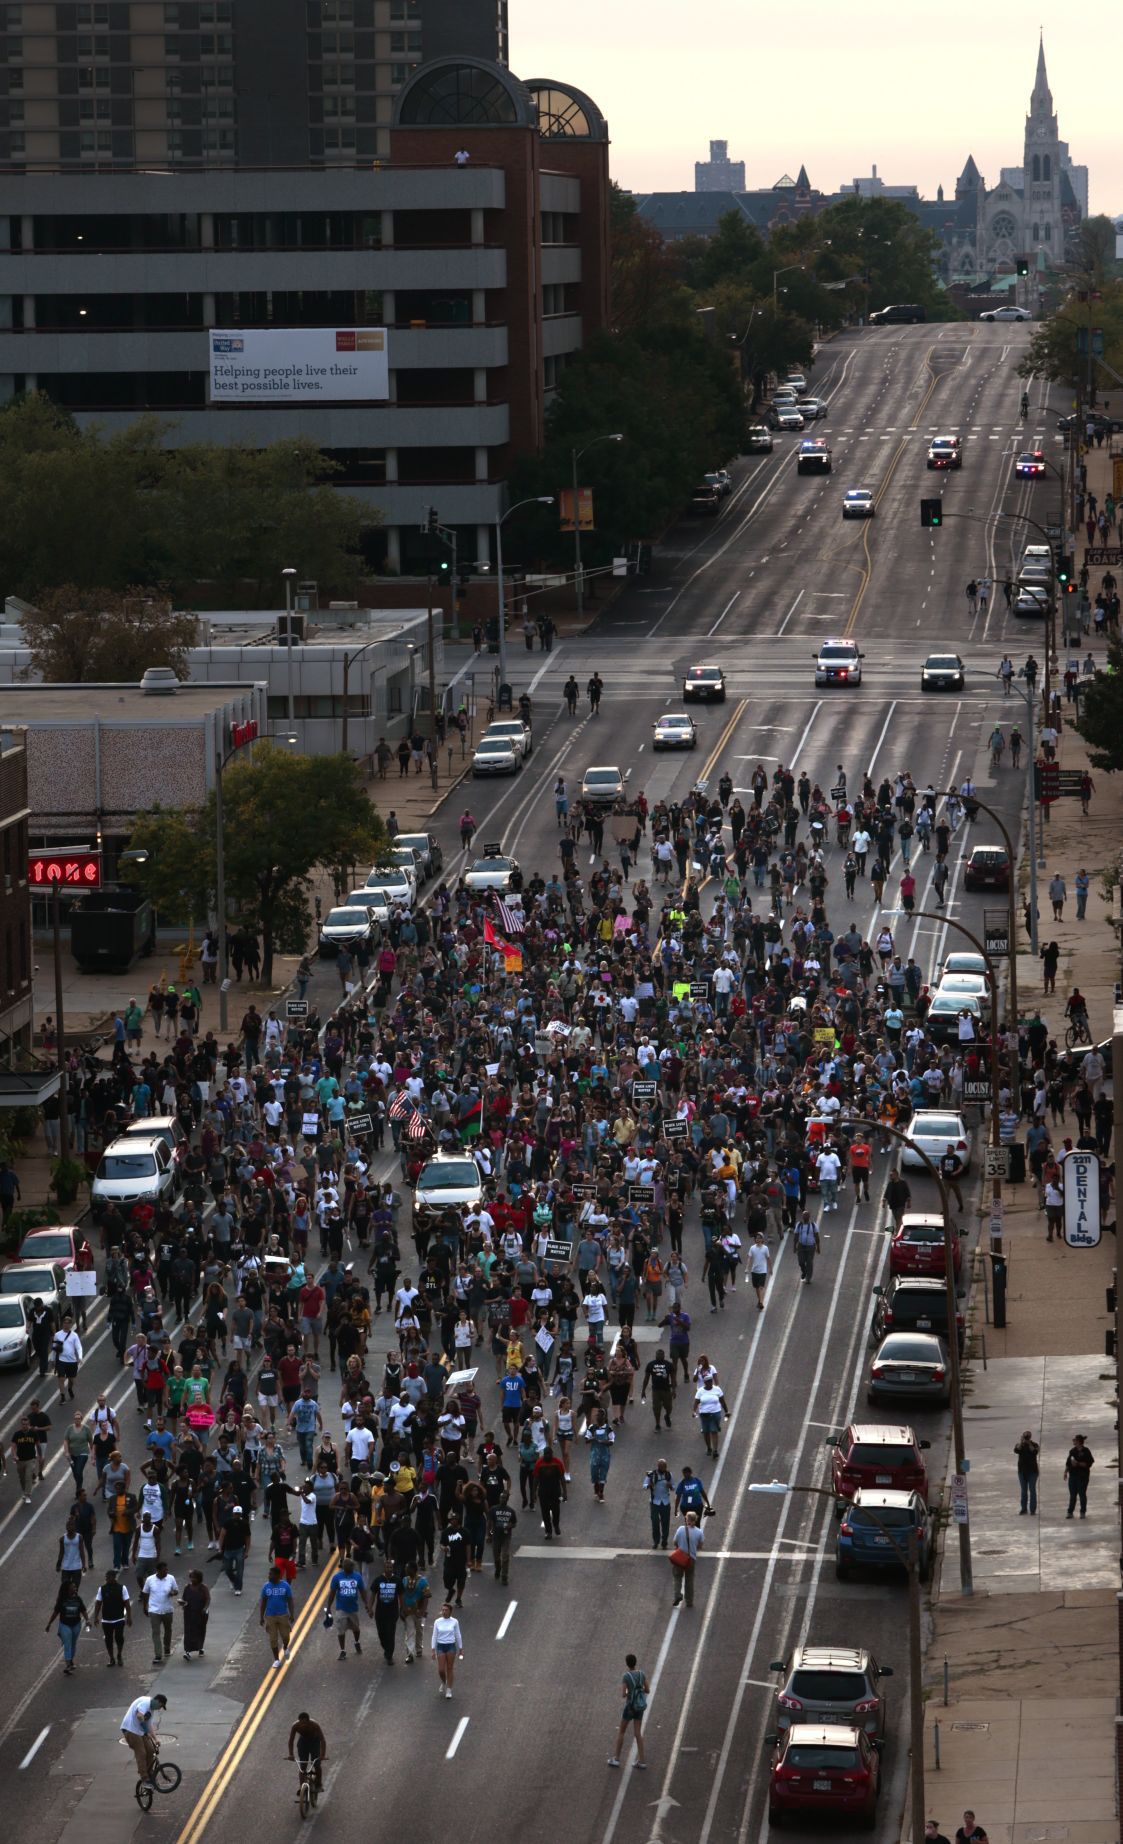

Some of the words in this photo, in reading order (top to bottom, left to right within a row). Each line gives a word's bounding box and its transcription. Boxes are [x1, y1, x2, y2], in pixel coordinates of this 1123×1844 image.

[213, 365, 260, 379] Helping
[263, 365, 303, 379] people
[305, 364, 327, 376] live
[329, 364, 358, 376] their
[213, 379, 238, 390] best
[242, 379, 290, 393] possible
[292, 379, 323, 390] lives.
[29, 861, 97, 882] tone
[986, 939, 1008, 950] LOCUST
[964, 1081, 989, 1094] LOCUST
[1072, 1156, 1091, 1164] 2211
[987, 1163, 1006, 1176] 35
[1076, 1165, 1088, 1233] DENTAL
[1070, 1234, 1095, 1244] Bldg.
[505, 1381, 519, 1391] SLU
